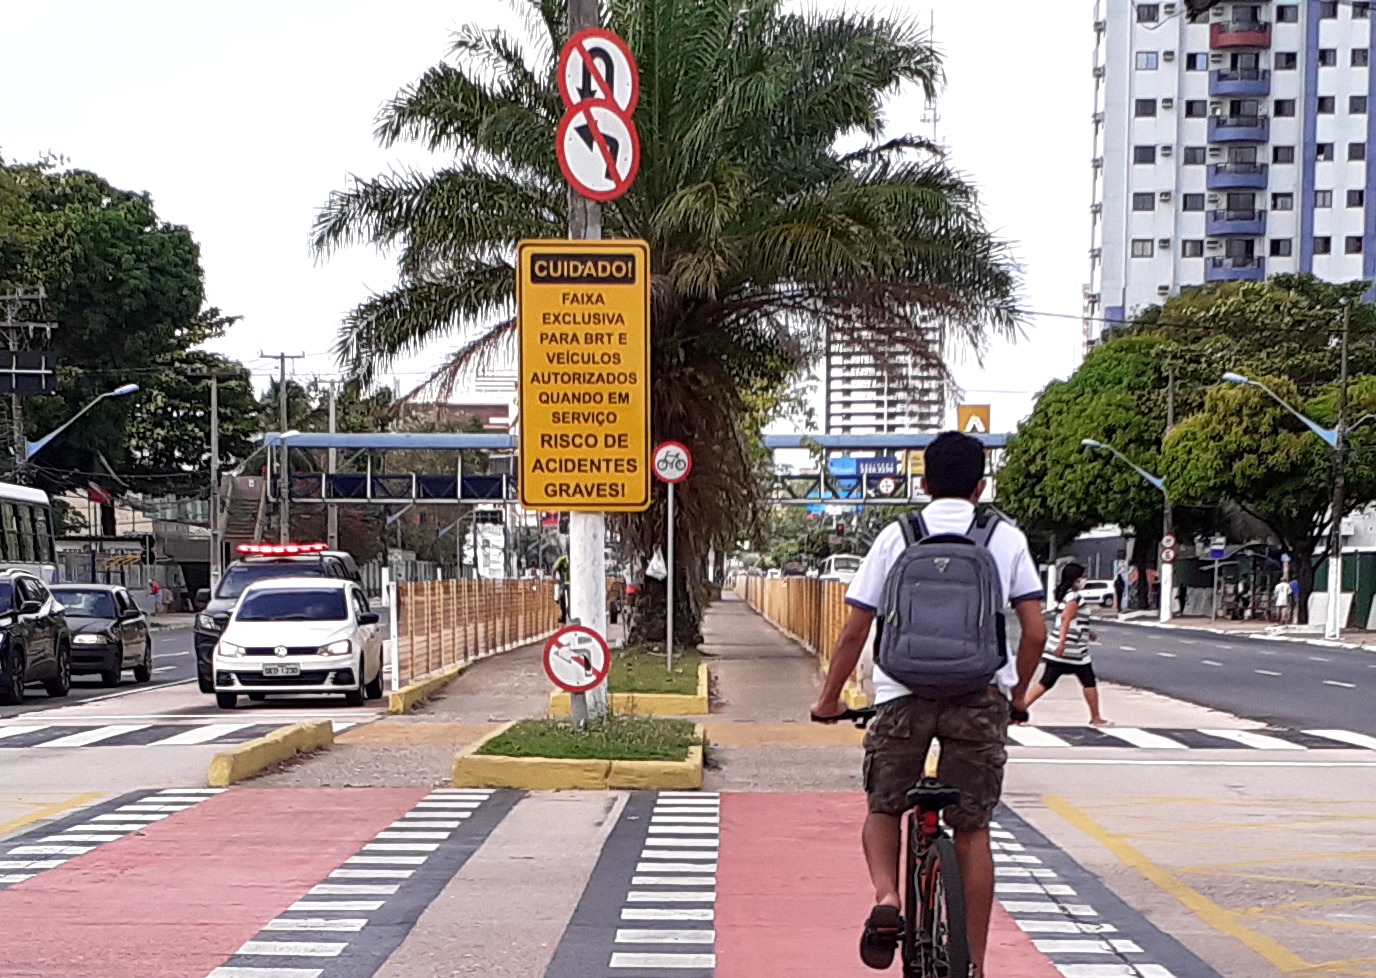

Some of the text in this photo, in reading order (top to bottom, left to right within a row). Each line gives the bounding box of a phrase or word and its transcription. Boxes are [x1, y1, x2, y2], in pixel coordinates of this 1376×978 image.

[534, 260, 633, 278] CUIDADO!
[562, 292, 605, 305] FAIXA
[542, 312, 625, 326] EXCLUSIVA
[539, 332, 627, 345] PARA BRT E
[546, 350, 621, 365] VEÍCULOS
[530, 372, 637, 385] AUTORIZADOS
[538, 391, 630, 405] QUANDO EM
[551, 411, 617, 426] SERVIÇO
[540, 433, 629, 449] RISCO DE
[531, 458, 638, 473] ACIDENTES
[544, 482, 625, 498] GRAVES!
